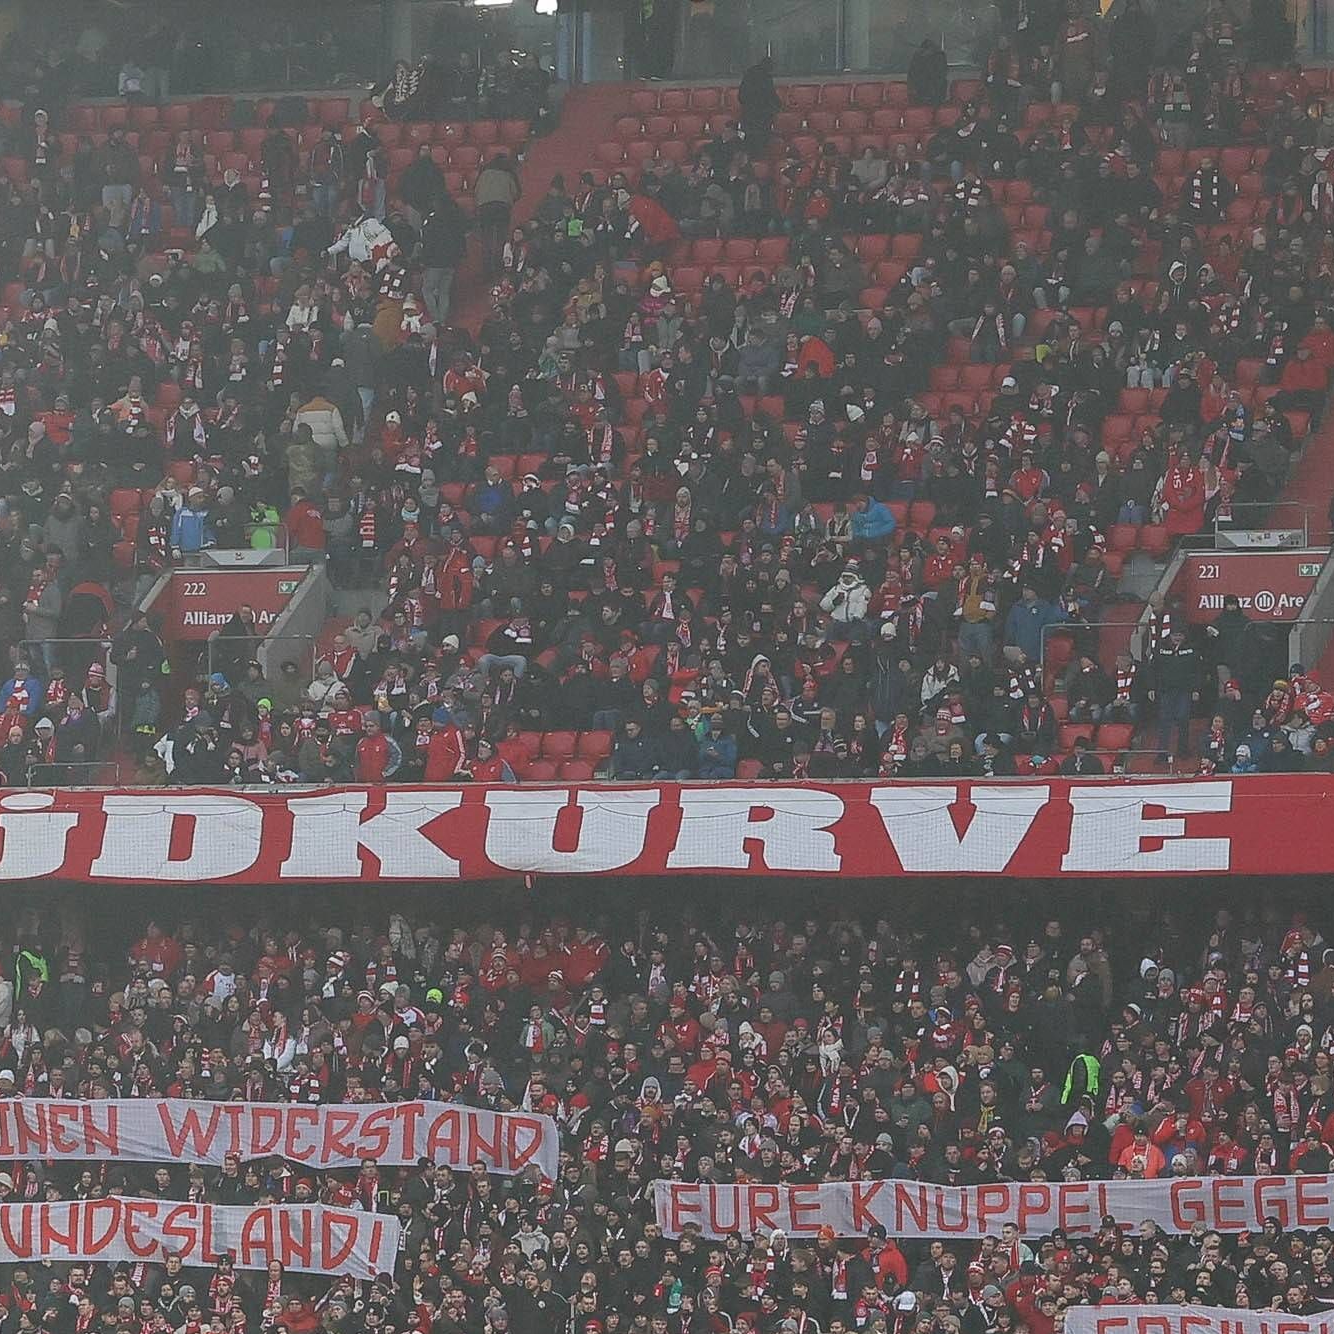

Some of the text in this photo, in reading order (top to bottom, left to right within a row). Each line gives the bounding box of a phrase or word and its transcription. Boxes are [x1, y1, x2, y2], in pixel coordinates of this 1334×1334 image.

[1199, 565, 1219, 579] 221
[184, 582, 207, 596] 222
[1199, 595, 1252, 609] Allinz
[157, 1101, 544, 1167] WIDERSTAND
[670, 1183, 825, 1232] EURE
